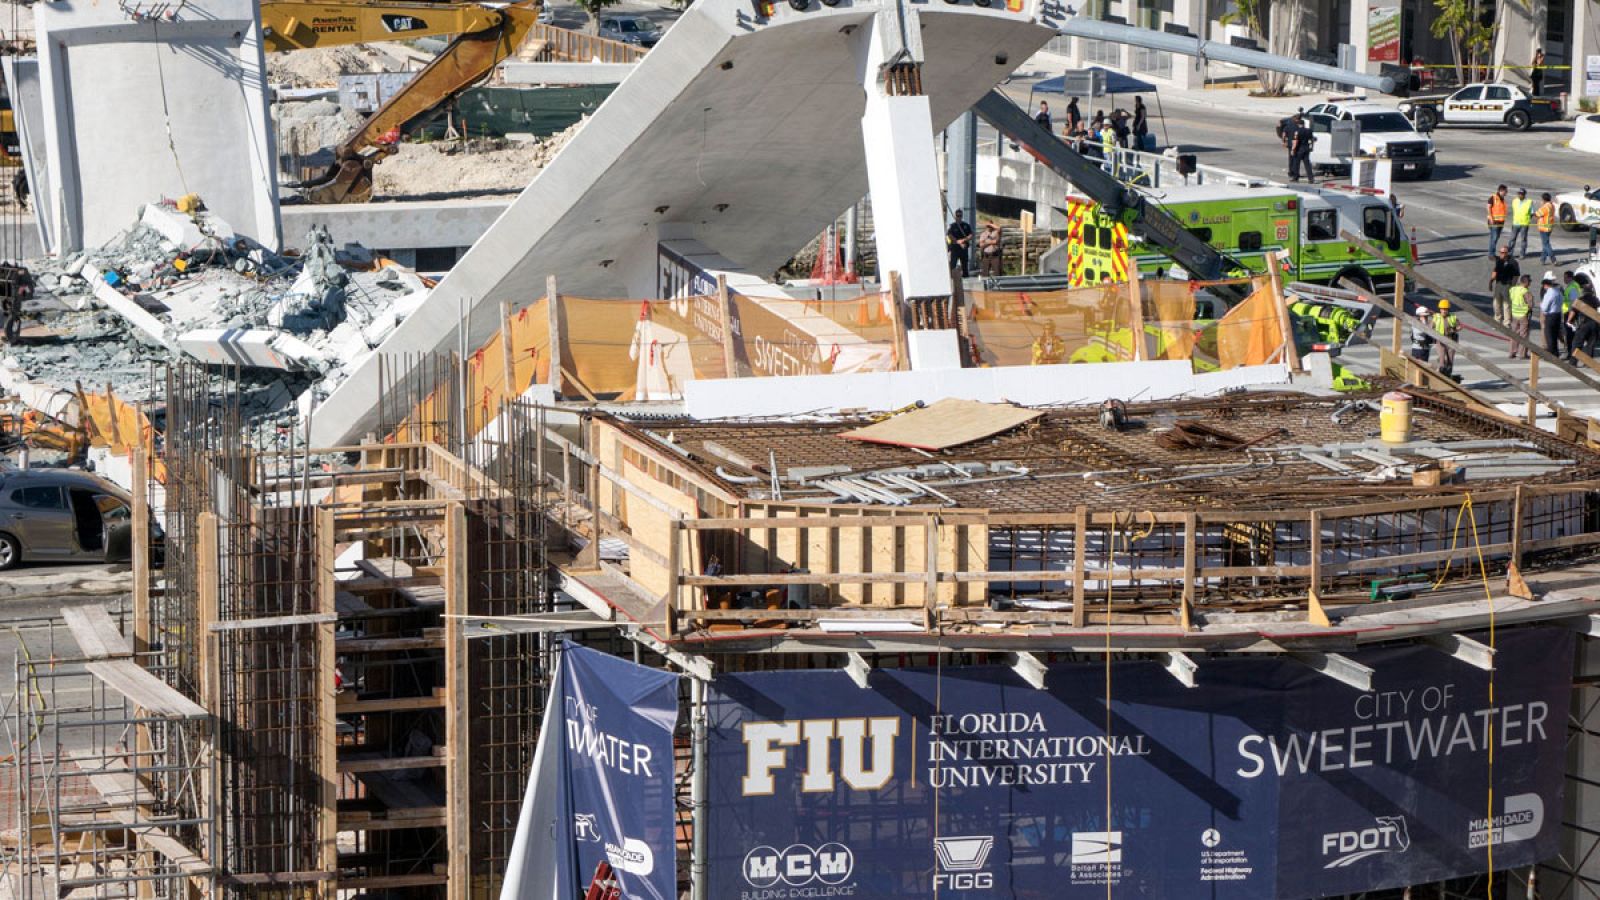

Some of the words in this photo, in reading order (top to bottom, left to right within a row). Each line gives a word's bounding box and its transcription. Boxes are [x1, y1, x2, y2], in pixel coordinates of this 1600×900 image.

[312, 24, 356, 33] RENTAL
[394, 18, 413, 30] CAT
[1448, 103, 1504, 112] POLICE
[1276, 227, 1288, 240] 69
[1354, 690, 1414, 721] CITY
[1421, 683, 1455, 712] OF
[929, 711, 1047, 736] FLORIDA
[928, 734, 1151, 762] INTERNATIONAL
[1236, 700, 1549, 779] SWEETWATER
[742, 716, 900, 796] FIU
[928, 762, 1097, 788] UNIVERSITY
[1468, 810, 1534, 831] MIAMI-DADE
[1322, 827, 1397, 857] FDOT
[1470, 831, 1502, 847] COUNTY
[749, 851, 848, 879] MCM
[741, 888, 787, 900] BUILDING
[789, 885, 856, 899] EXCELLENCE
[932, 871, 993, 891] FIGG
